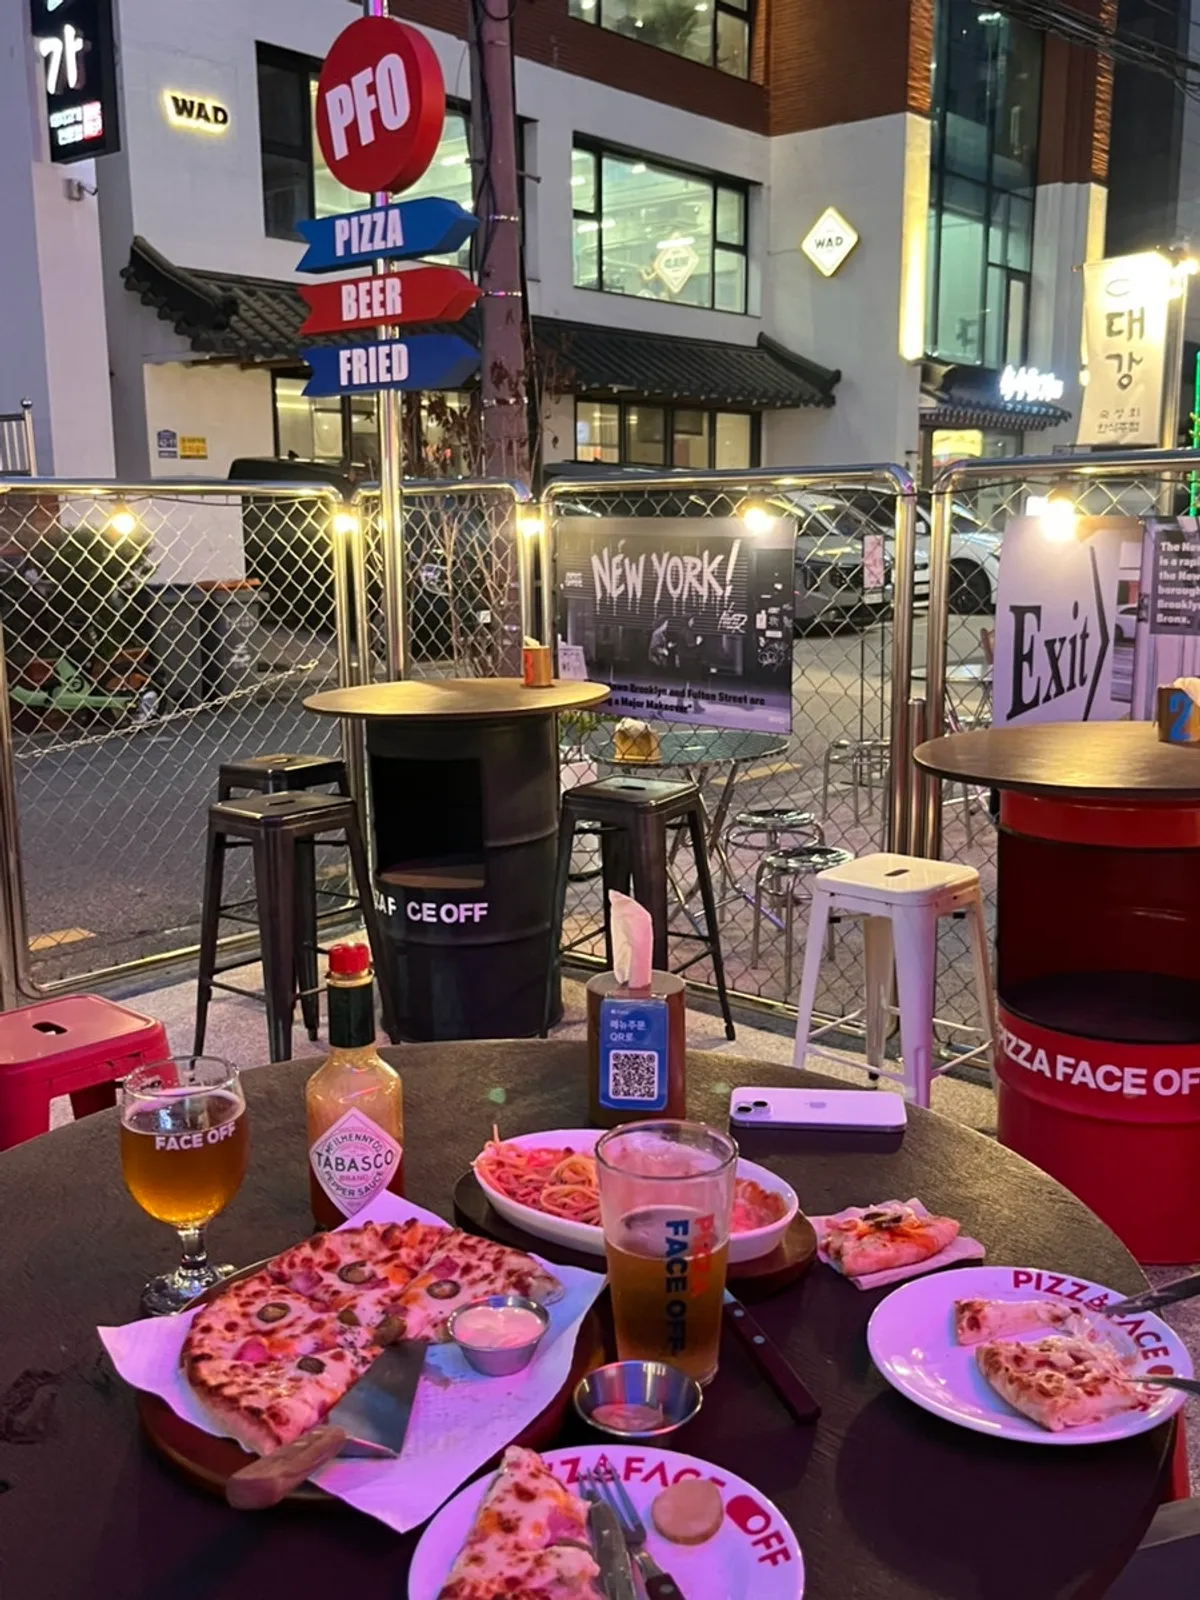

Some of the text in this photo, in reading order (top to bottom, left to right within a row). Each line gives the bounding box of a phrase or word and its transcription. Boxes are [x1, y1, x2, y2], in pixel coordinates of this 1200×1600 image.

[171, 95, 228, 125] WAD
[325, 52, 411, 161] PFO
[334, 208, 404, 257] PIZZA
[814, 236, 844, 250] WAD
[341, 277, 403, 322] BEER
[338, 343, 409, 387] FRIED
[1159, 556, 1169, 566] is
[1161, 542, 1180, 551] The
[651, 539, 741, 606] YORK!
[1159, 571, 1176, 580] the
[1006, 600, 1090, 721] Exit
[621, 697, 644, 709] Major
[630, 684, 667, 697] Brooklyn
[669, 688, 685, 698] and
[687, 690, 716, 701] Fulton
[718, 691, 749, 704] Street
[750, 697, 765, 706] are
[1168, 692, 1194, 741] 2
[1056, 1054, 1147, 1095] FACE
[155, 1121, 236, 1151] FACE OFF
[315, 1149, 394, 1172] TABASCO
[665, 1219, 690, 1358] FACE OFF
[735, 1502, 792, 1567] OFF
